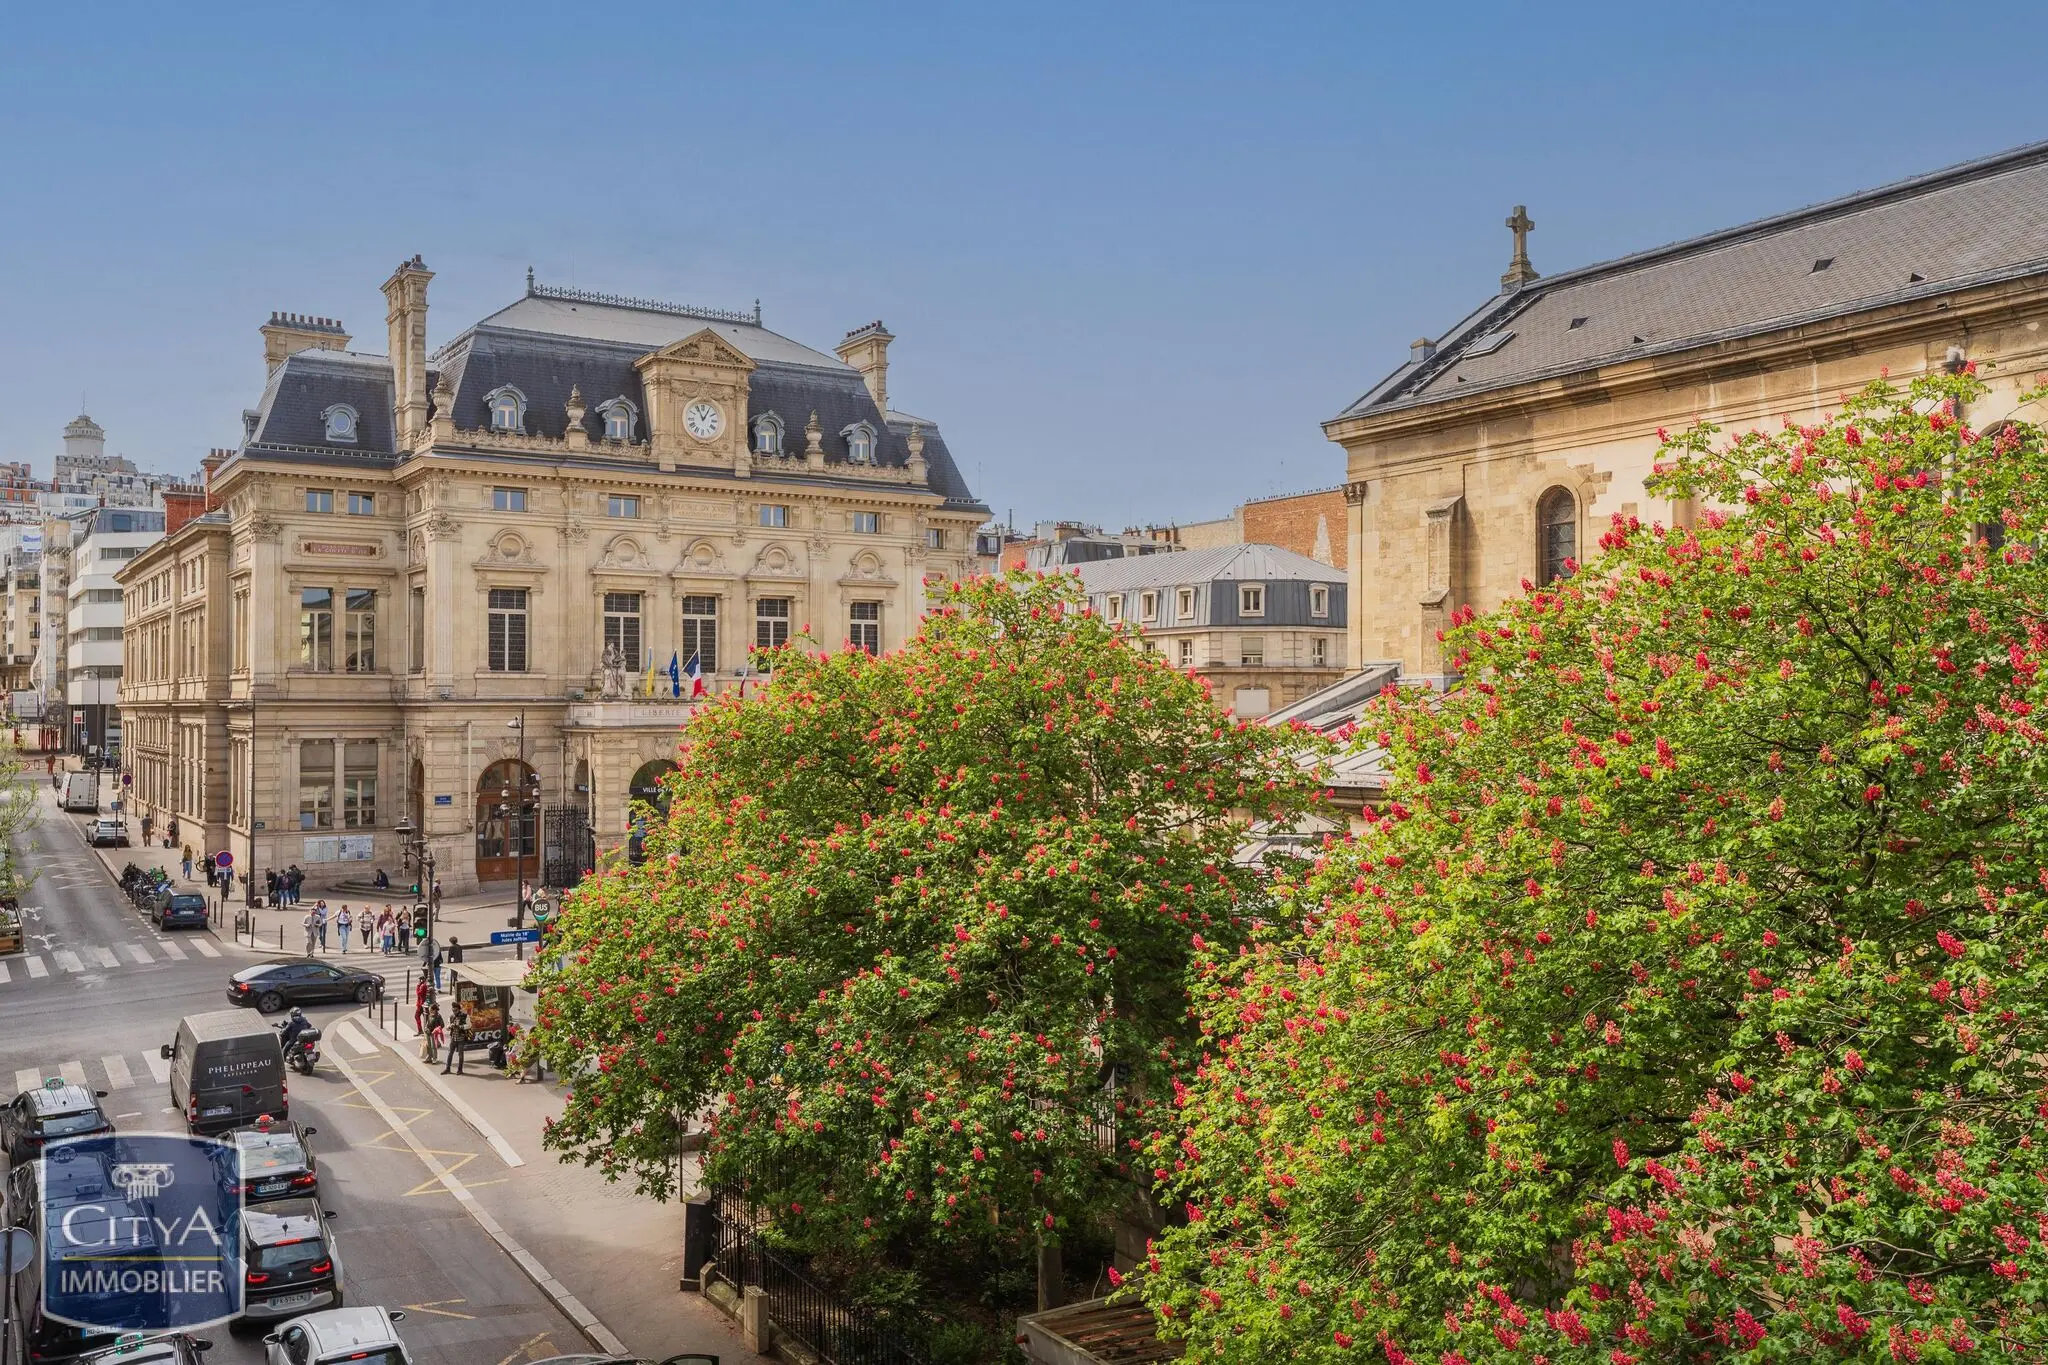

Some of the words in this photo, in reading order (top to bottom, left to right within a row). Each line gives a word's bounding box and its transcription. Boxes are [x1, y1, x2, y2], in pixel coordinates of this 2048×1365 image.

[534, 903, 548, 911] BUS
[473, 1029, 502, 1042] KFC
[208, 1059, 272, 1075] PHELIPPEAU
